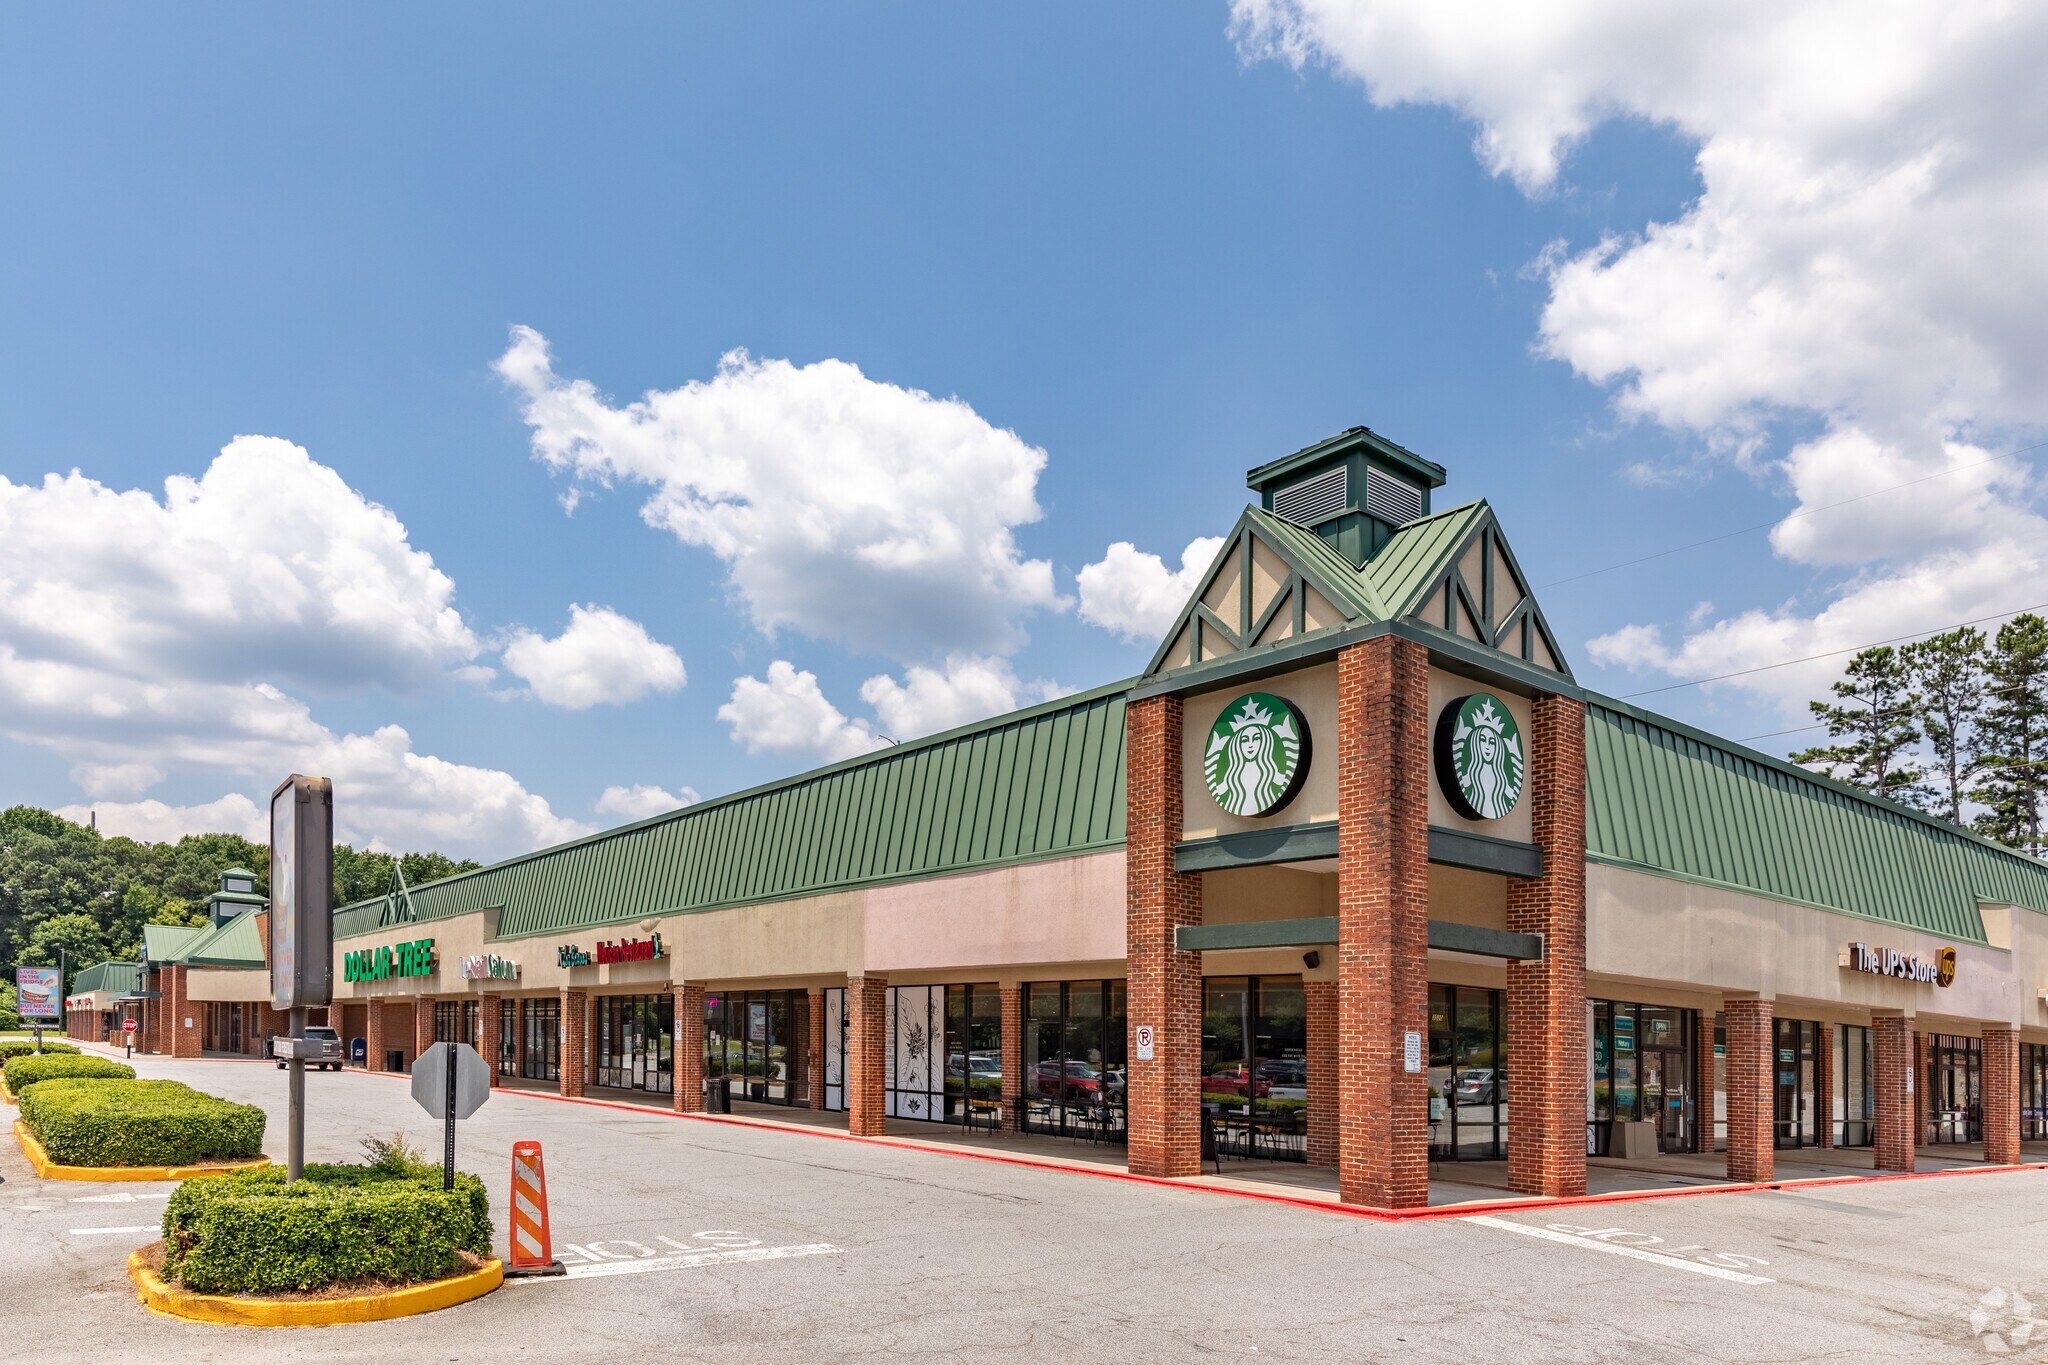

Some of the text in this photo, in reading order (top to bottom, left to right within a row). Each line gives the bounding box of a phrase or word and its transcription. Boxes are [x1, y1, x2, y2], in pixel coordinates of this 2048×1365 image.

[344, 938, 433, 982] DOLLAR TREE
[1856, 942, 1938, 984] The UPS Store
[1942, 959, 1955, 981] ups
[1655, 1022, 1667, 1030] OPEN
[1595, 1039, 1603, 1049] We
[1595, 1064, 1607, 1074] Print
